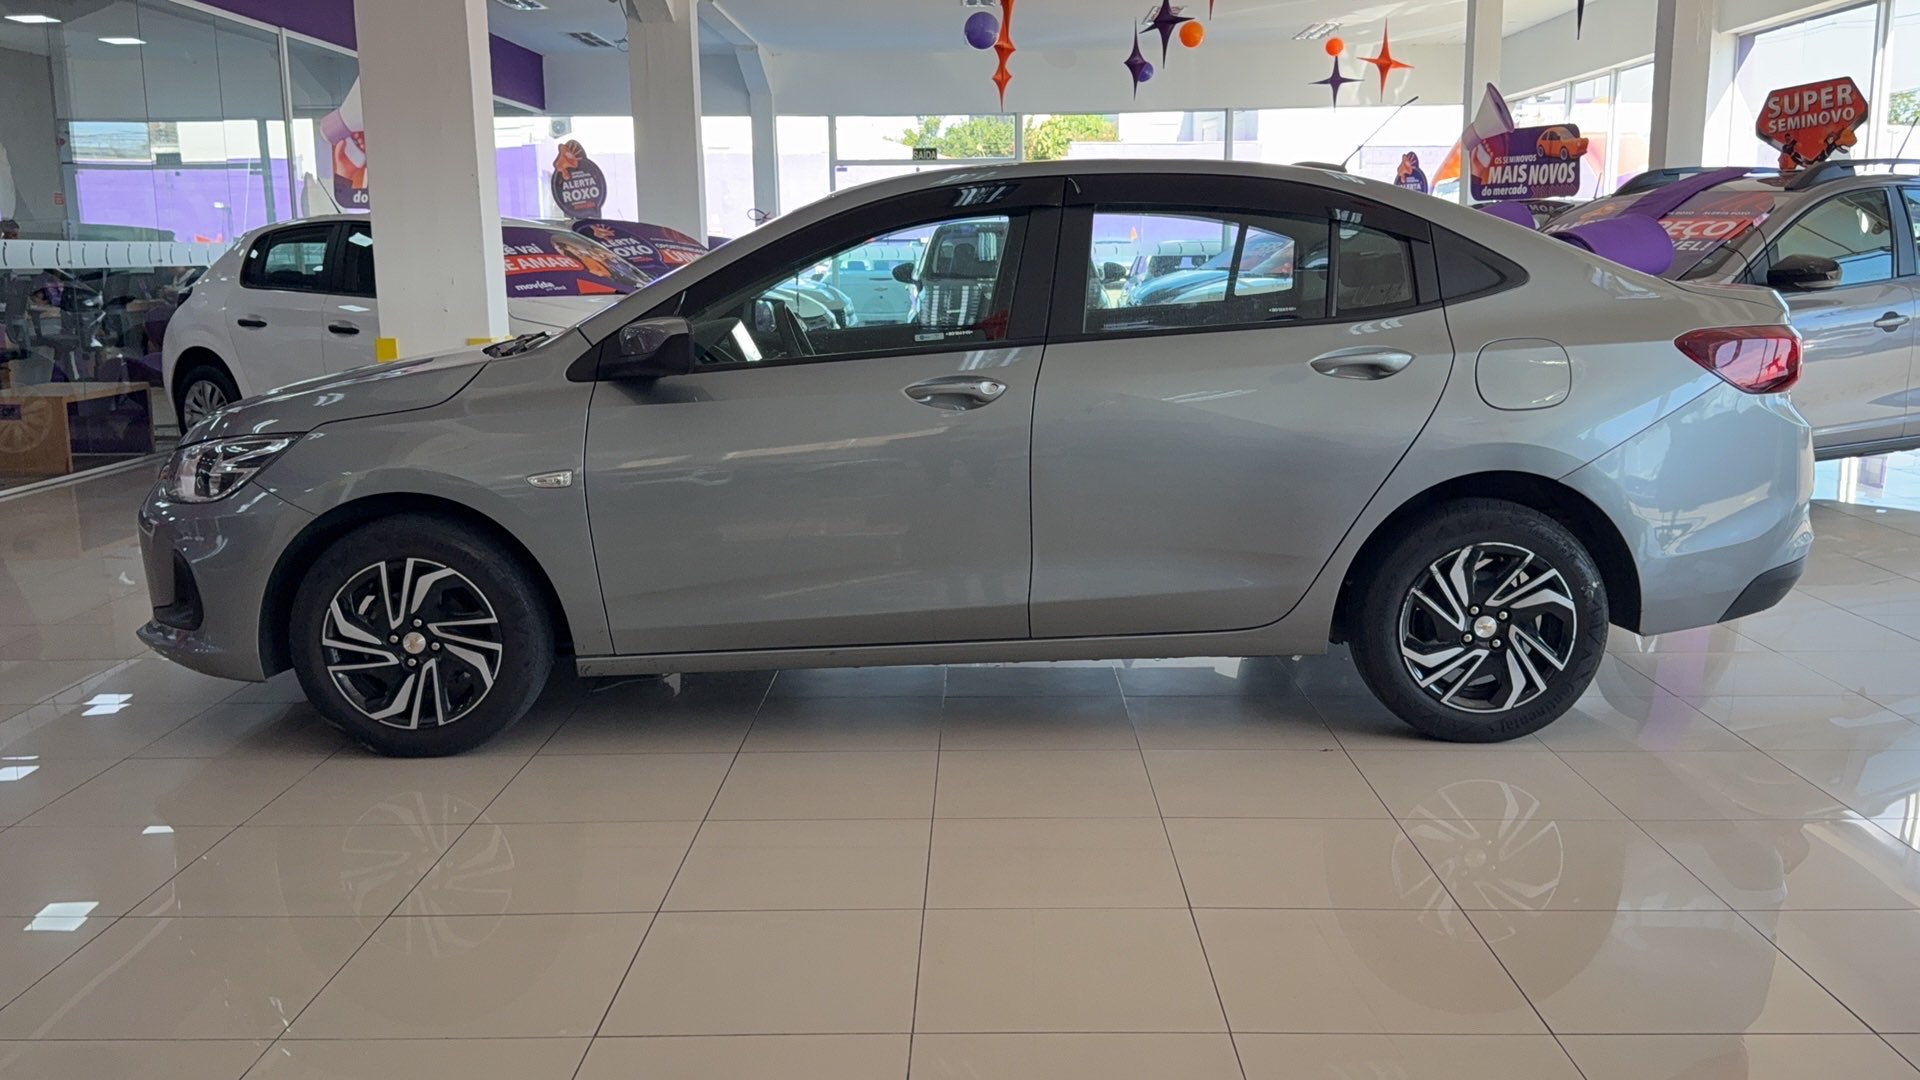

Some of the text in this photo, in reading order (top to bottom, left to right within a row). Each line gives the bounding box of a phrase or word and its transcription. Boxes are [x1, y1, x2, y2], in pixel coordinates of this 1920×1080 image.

[1768, 84, 1853, 119] SUPER
[1768, 107, 1855, 133] SEMINOVO
[913, 148, 937, 160] SAÍDA
[1495, 154, 1537, 164] OS SEMINOVOS
[1488, 162, 1576, 185] MAIS NOVOS
[562, 177, 596, 190] ALERTA
[1481, 184, 1528, 196] do mercado
[353, 190, 368, 203] do
[562, 187, 600, 203] ROXO
[515, 243, 544, 254] vai
[601, 237, 640, 248] LERTA
[613, 244, 654, 258] OXO
[517, 256, 581, 270] AMAR!
